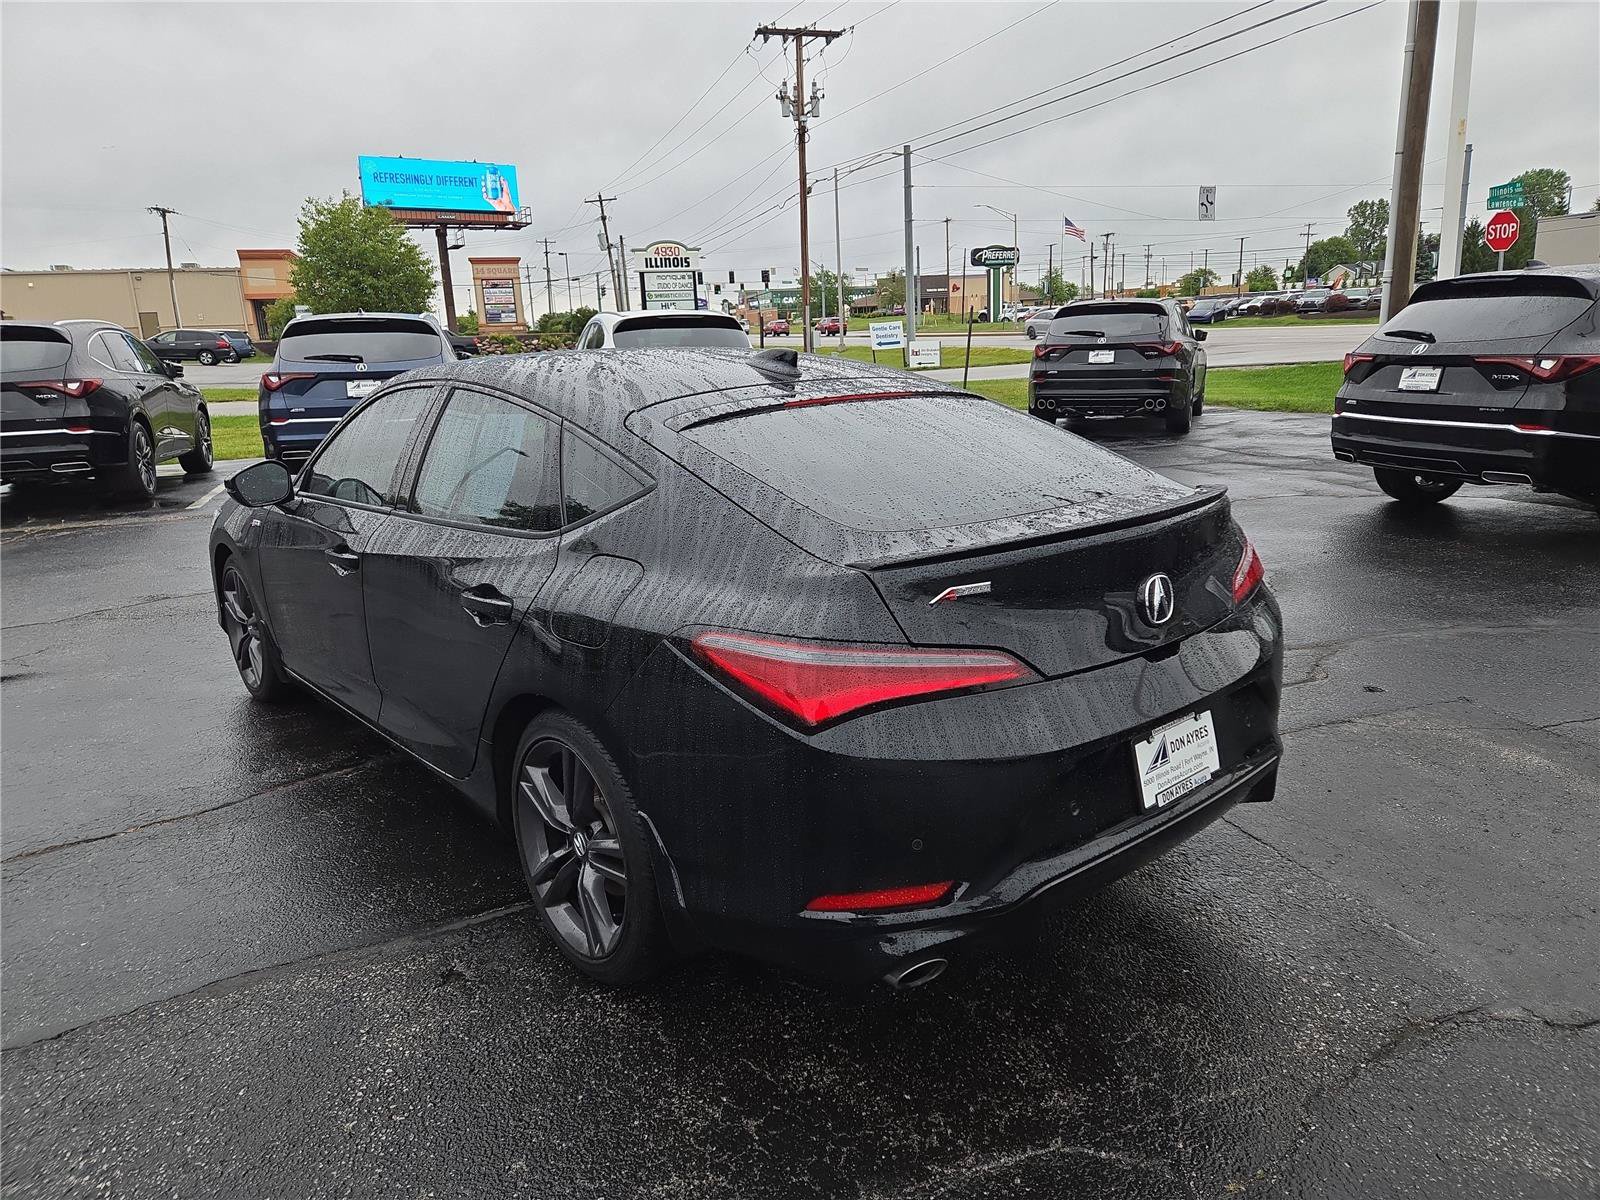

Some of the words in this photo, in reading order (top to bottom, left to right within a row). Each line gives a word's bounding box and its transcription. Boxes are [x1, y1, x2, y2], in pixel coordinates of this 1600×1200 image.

[373, 171, 433, 186] REFRESHINGLY
[436, 175, 478, 188] DIFFERENT
[1489, 185, 1514, 197] Illinois
[1488, 199, 1517, 209] Lawrence
[1487, 223, 1517, 240] STOP
[654, 246, 680, 257] 4930
[644, 257, 690, 269] ILLINOIS
[486, 267, 518, 275] SQUARE
[657, 282, 671, 290] STUDIO
[678, 281, 693, 289] DANCE
[1170, 736, 1187, 754] DON
[1186, 725, 1209, 746] AYRES
[1170, 763, 1182, 774] Road
[1162, 789, 1175, 803] DON
[1175, 779, 1193, 796] AYRES
